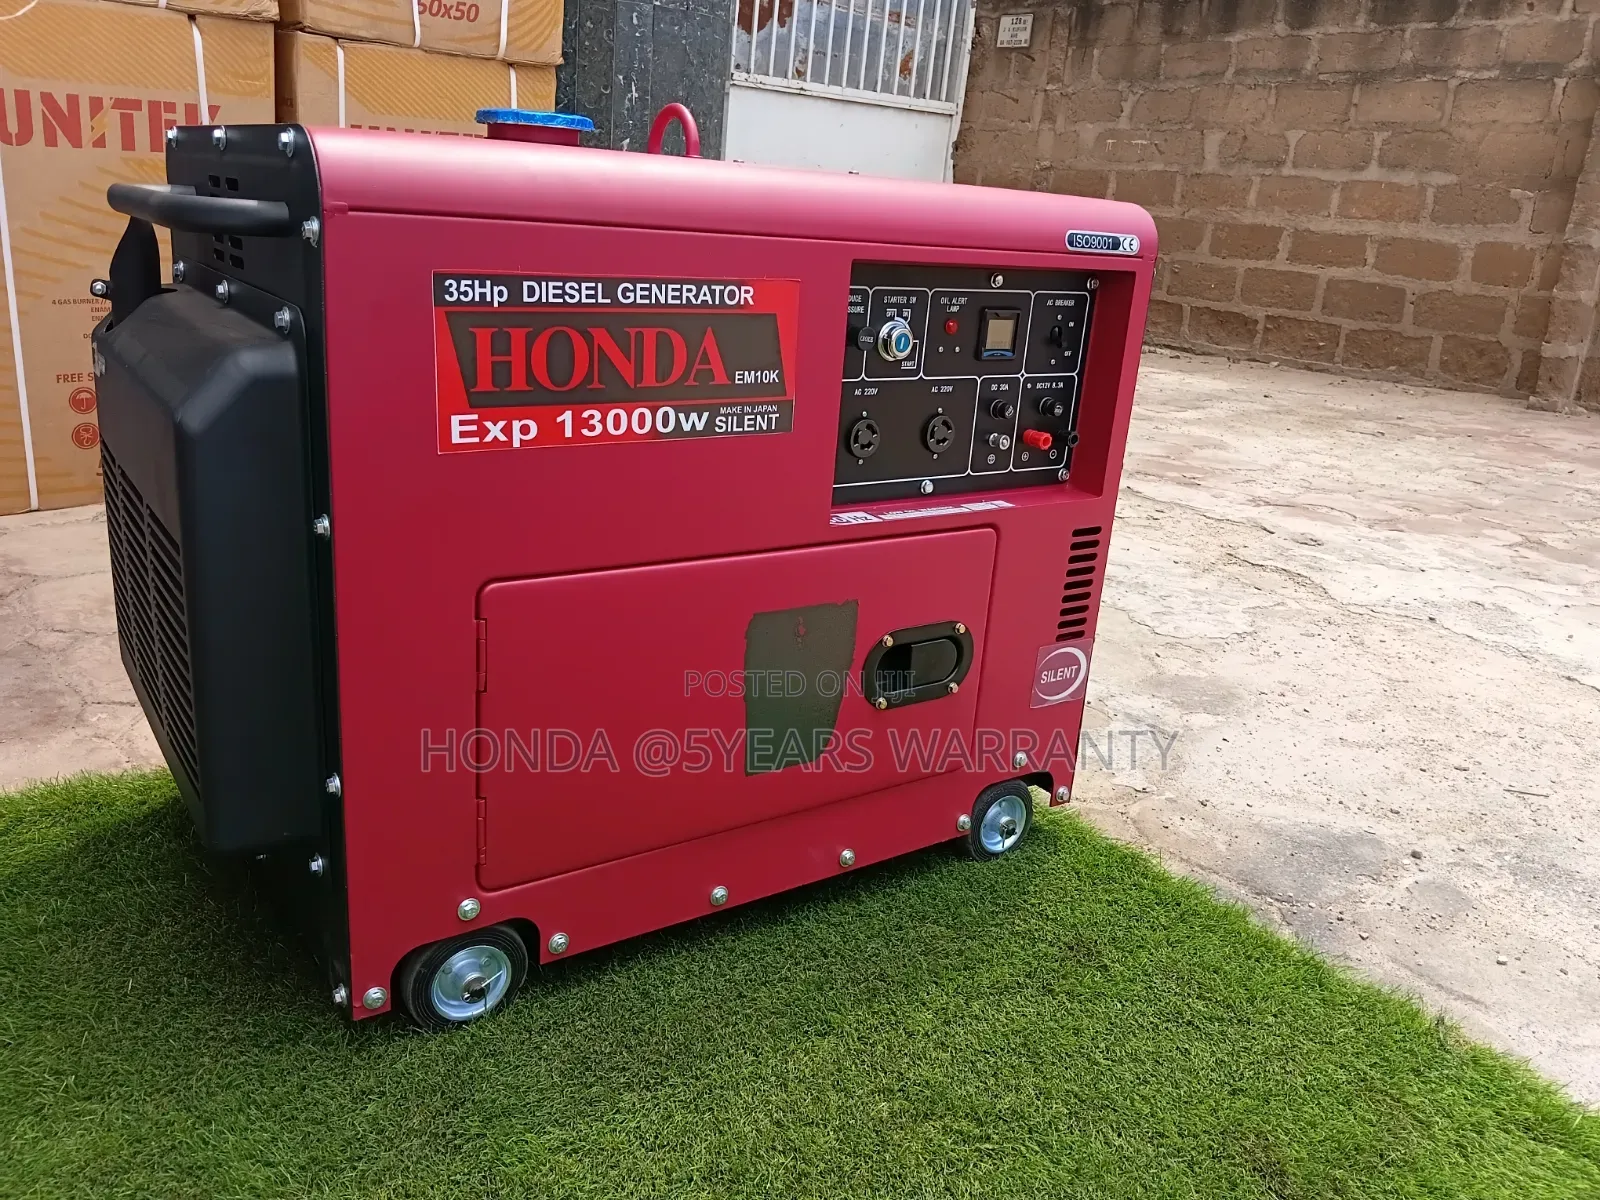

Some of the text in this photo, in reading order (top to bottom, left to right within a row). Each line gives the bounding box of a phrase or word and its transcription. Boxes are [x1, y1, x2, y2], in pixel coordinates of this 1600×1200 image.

[1073, 234, 1113, 250] ISO9001
[444, 279, 755, 307] 35Hp DIESEL GENERATOR
[884, 296, 917, 304] STARTER SW
[951, 297, 968, 305] ALERT
[946, 305, 960, 313] LAMP
[469, 326, 732, 393] HONDA
[56, 373, 84, 384] FREE
[734, 370, 780, 384] EM10K
[854, 387, 878, 396] AC 220V
[940, 385, 953, 393] 220V
[991, 383, 998, 391] DC
[720, 404, 778, 414] MAKE IN JAPAN
[450, 405, 710, 448] Exp 13000w
[714, 413, 780, 433] SILENT
[1040, 665, 1079, 684] SILENT
